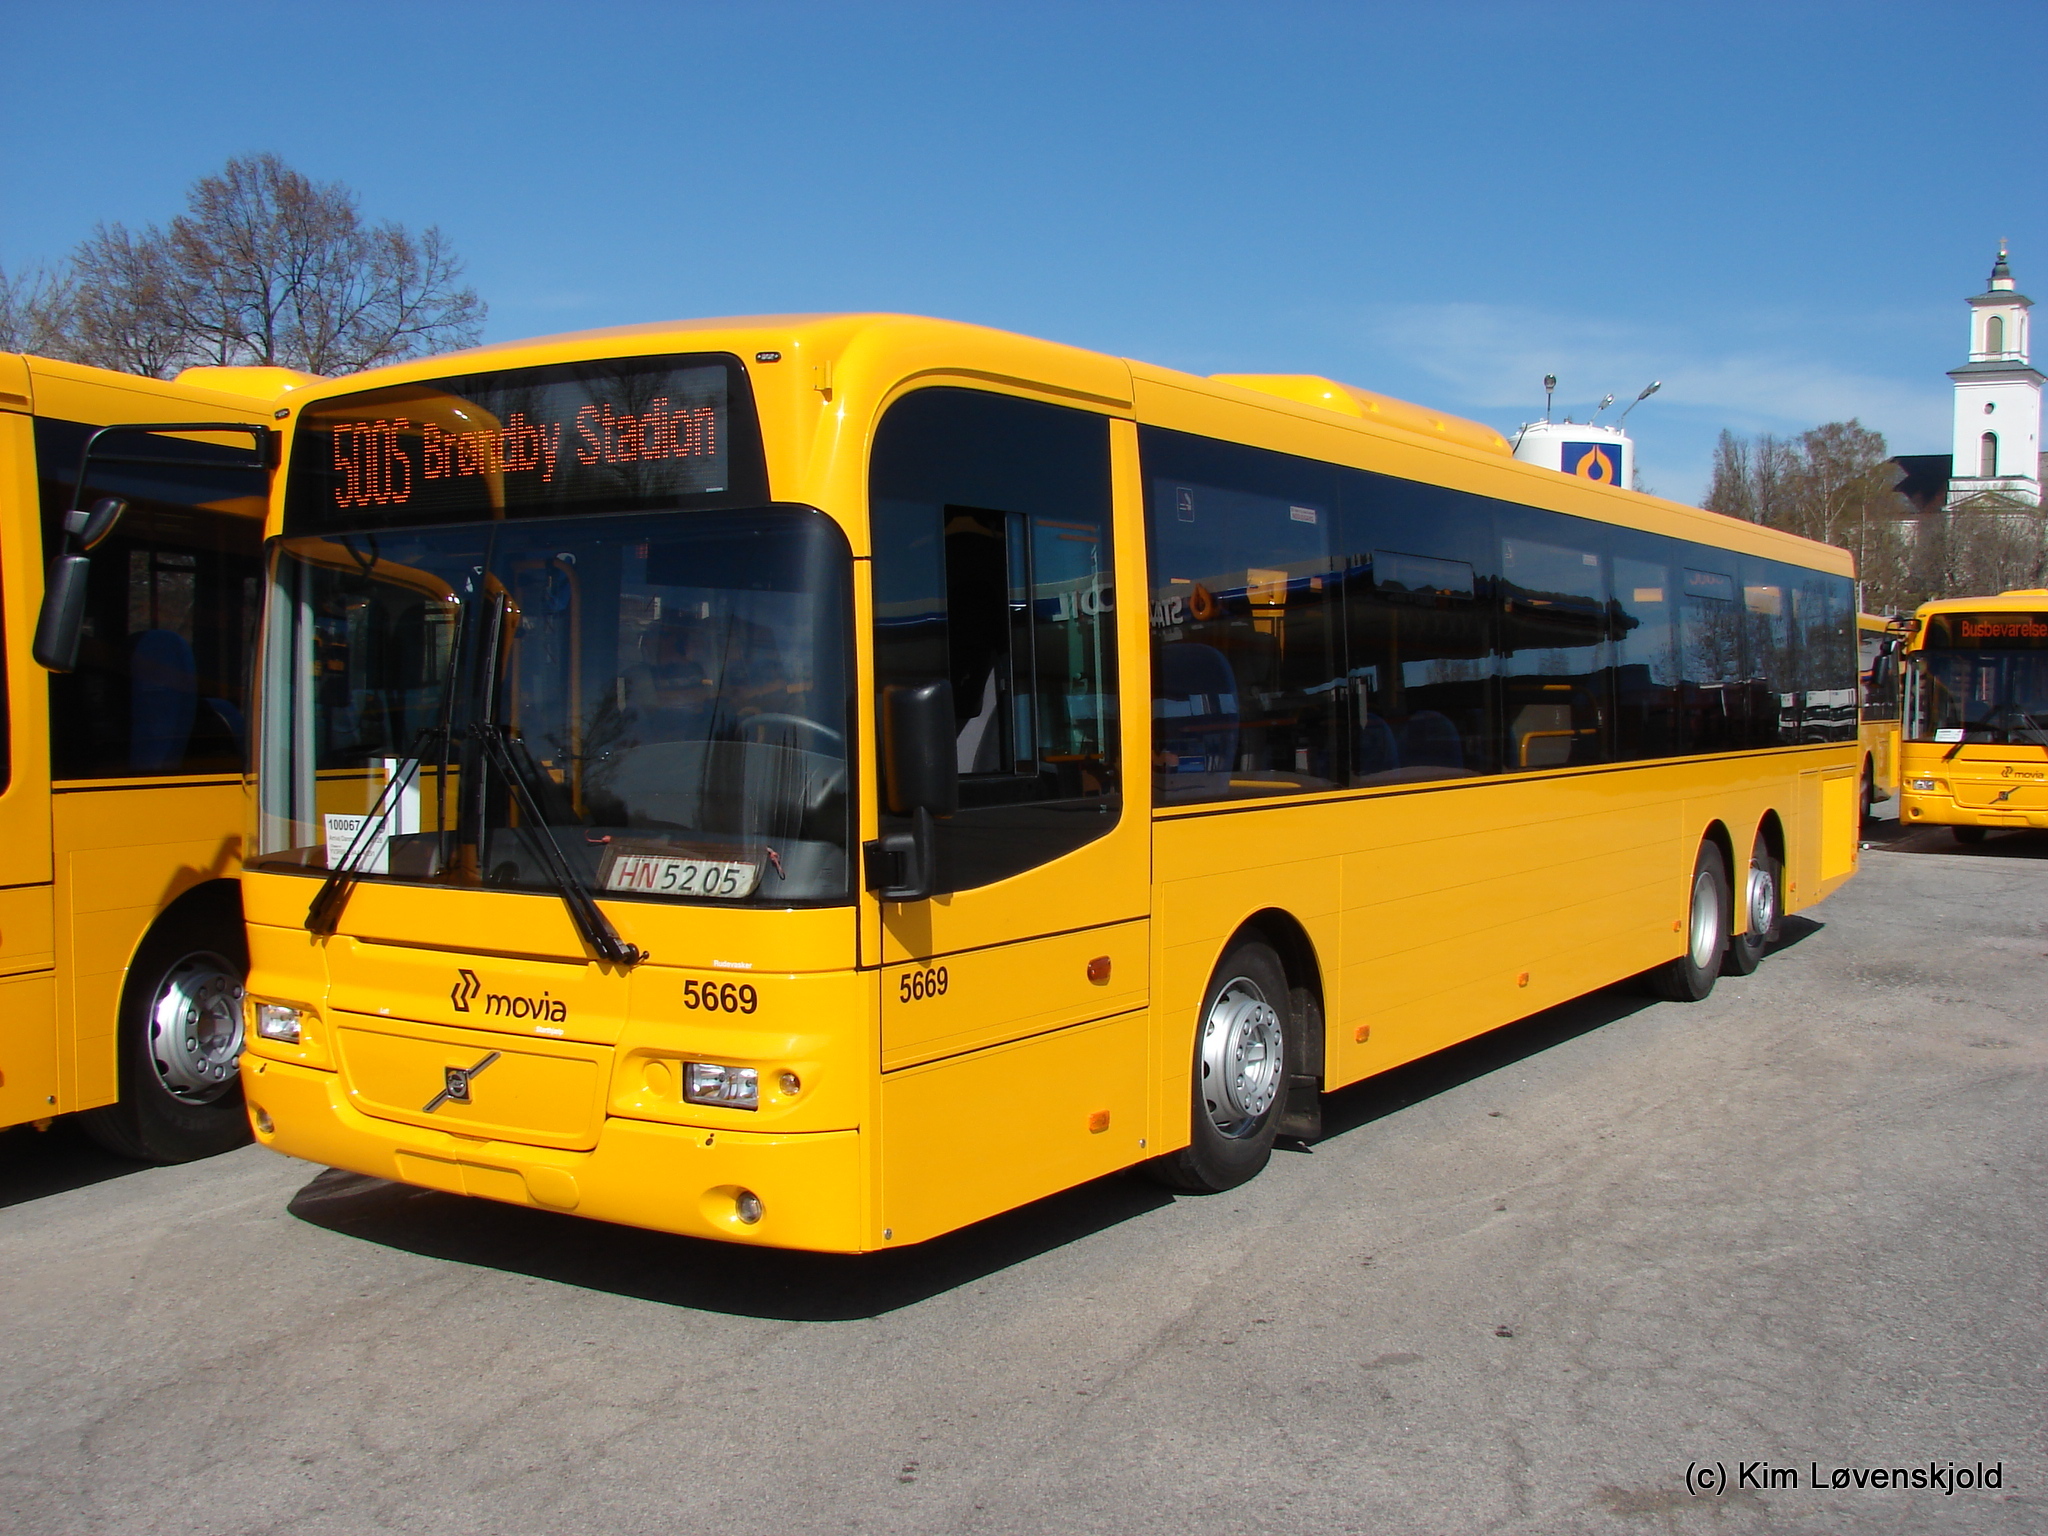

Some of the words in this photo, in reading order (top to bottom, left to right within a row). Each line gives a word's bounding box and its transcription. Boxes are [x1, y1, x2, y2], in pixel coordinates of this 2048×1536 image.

[334, 417, 411, 508] 5005
[577, 397, 715, 465] Stadion
[328, 819, 361, 831] 100067
[617, 861, 659, 889] HN
[683, 979, 758, 1014] 5669
[900, 966, 948, 1003] 5669
[485, 991, 567, 1023] movia
